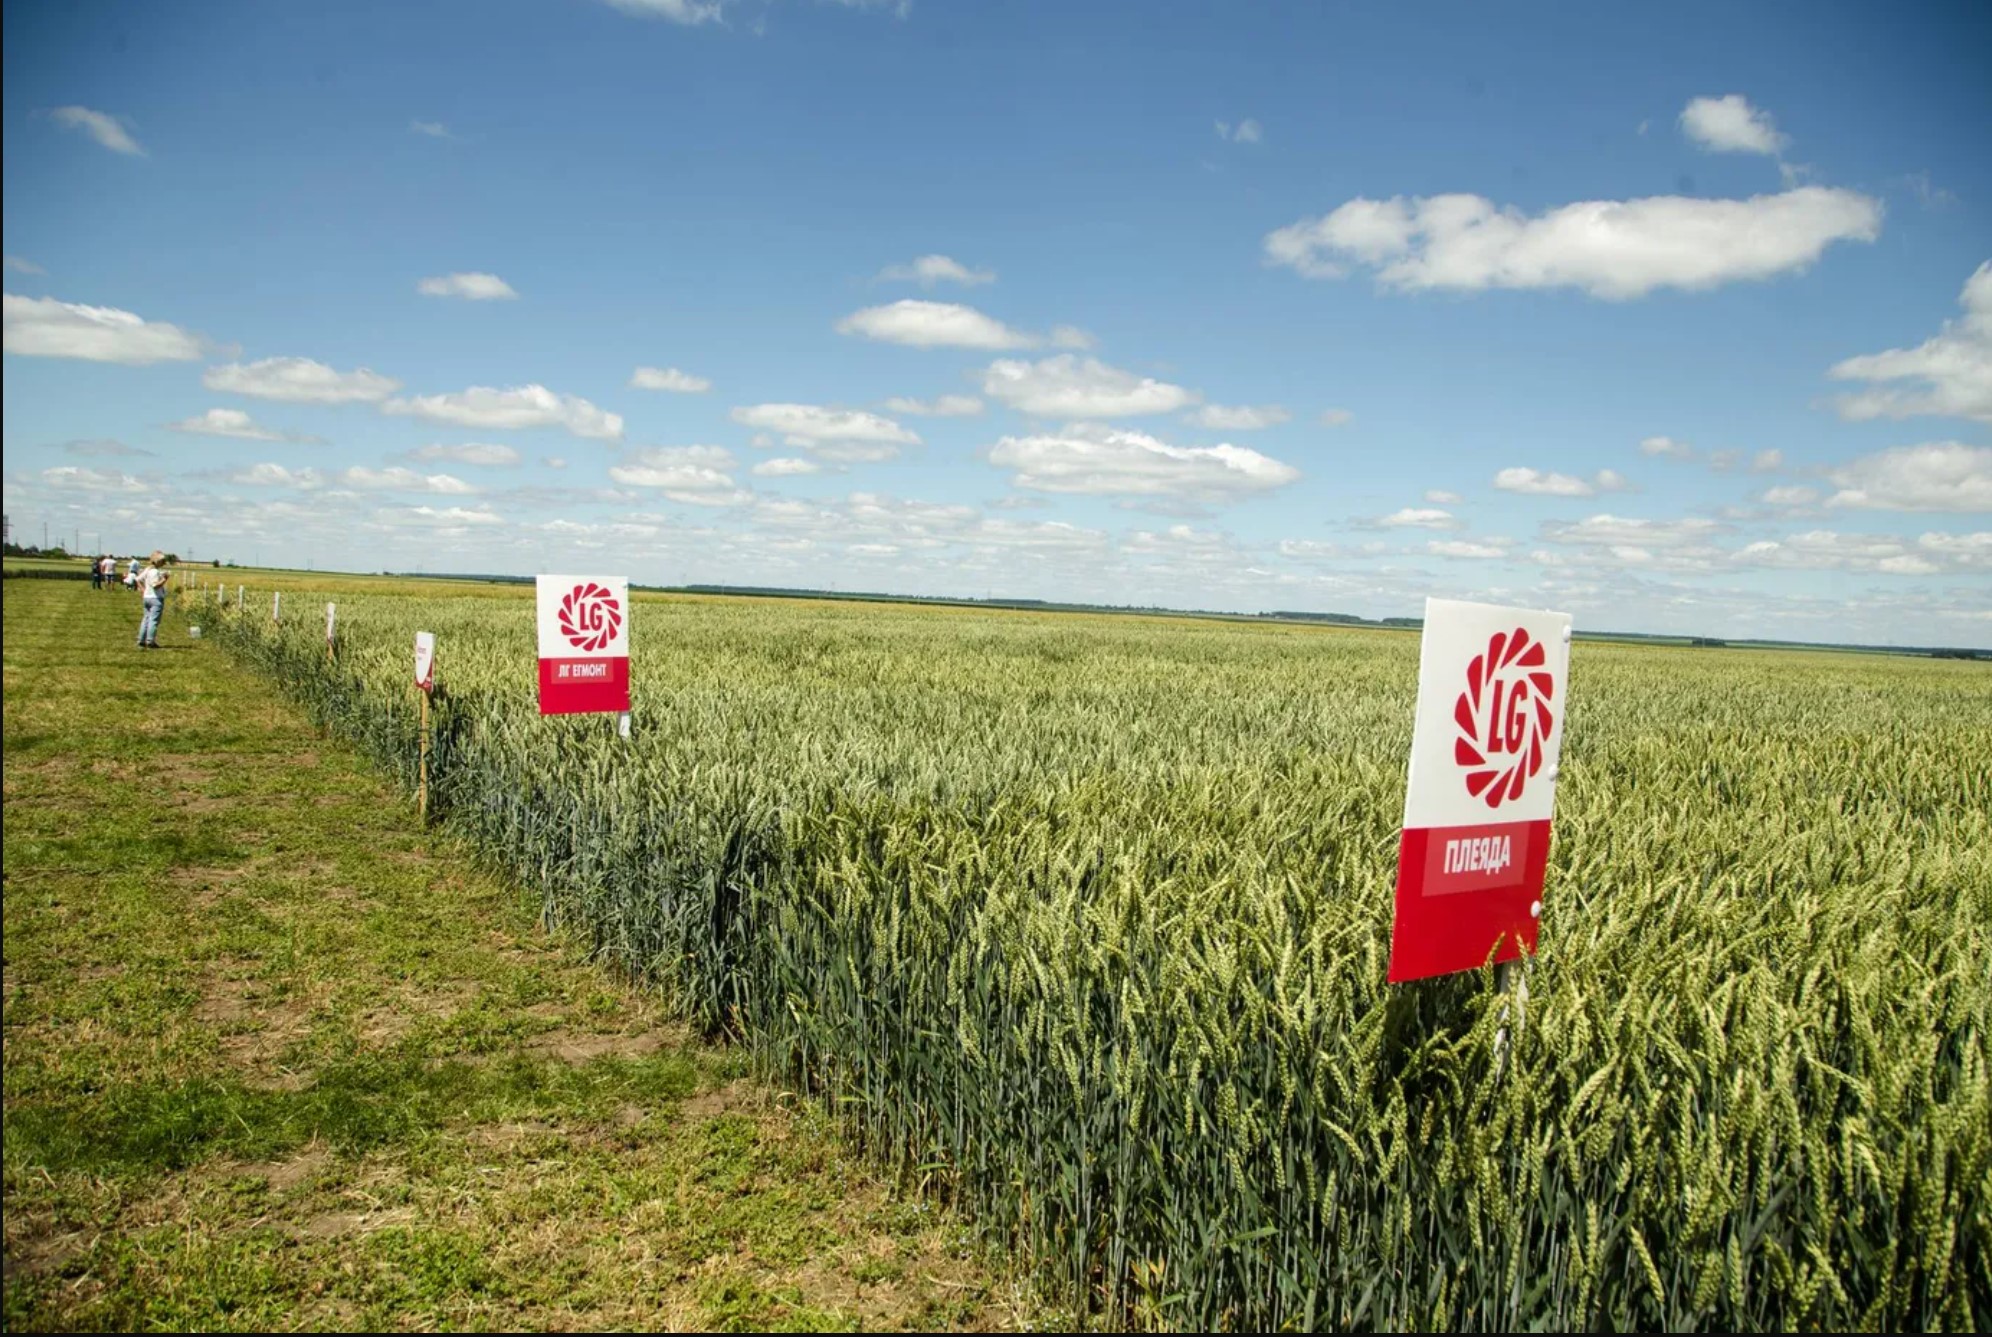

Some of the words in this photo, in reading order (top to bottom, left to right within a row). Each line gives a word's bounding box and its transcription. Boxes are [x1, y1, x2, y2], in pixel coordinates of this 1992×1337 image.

[579, 602, 603, 631] LG
[573, 663, 607, 677] ЕГМОНТ
[1487, 679, 1528, 754] LG
[1443, 835, 1511, 875] ПЛЕЯДА
